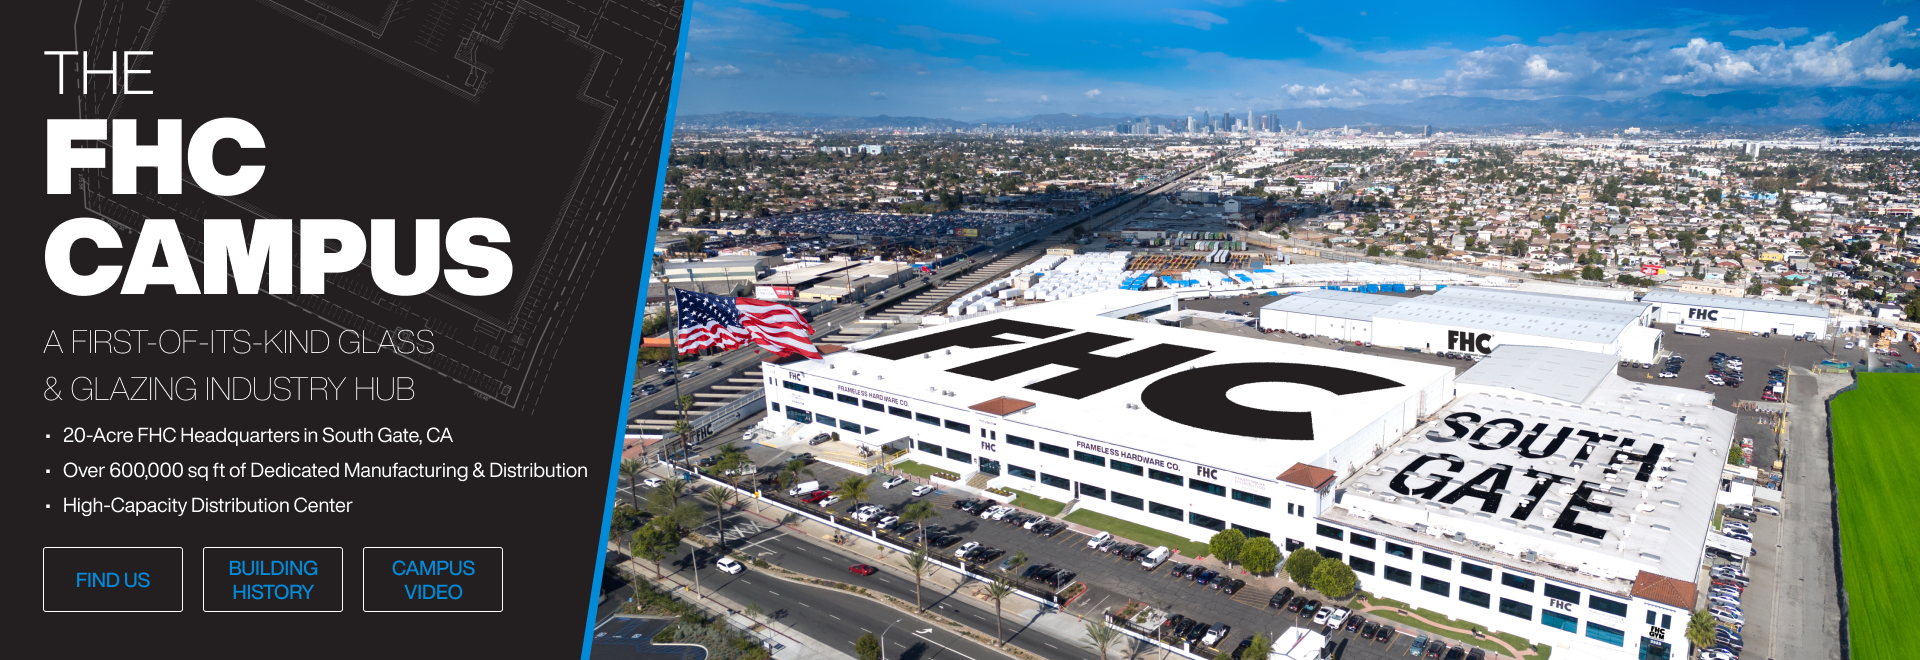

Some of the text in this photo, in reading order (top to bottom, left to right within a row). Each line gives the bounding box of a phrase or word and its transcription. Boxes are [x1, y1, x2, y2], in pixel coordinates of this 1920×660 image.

[1688, 308, 1719, 321] FHC
[1448, 330, 1492, 354] FHC
[789, 371, 801, 381] FHC
[857, 318, 1406, 440] FHC
[837, 385, 910, 407] FRAMELESS HARDWARE CO.
[696, 423, 713, 441] FHC
[981, 441, 996, 452] FHC
[1425, 412, 1665, 482] SOUTH
[1076, 440, 1181, 471] FRAMELESS HARDWARE CO.
[1197, 465, 1218, 480] FHC
[1320, 484, 1330, 498] FHC
[1389, 453, 1628, 539] GATE
[1550, 598, 1572, 612] FHC
[1649, 631, 1665, 640] GYM
[1651, 626, 1665, 634] FHC
